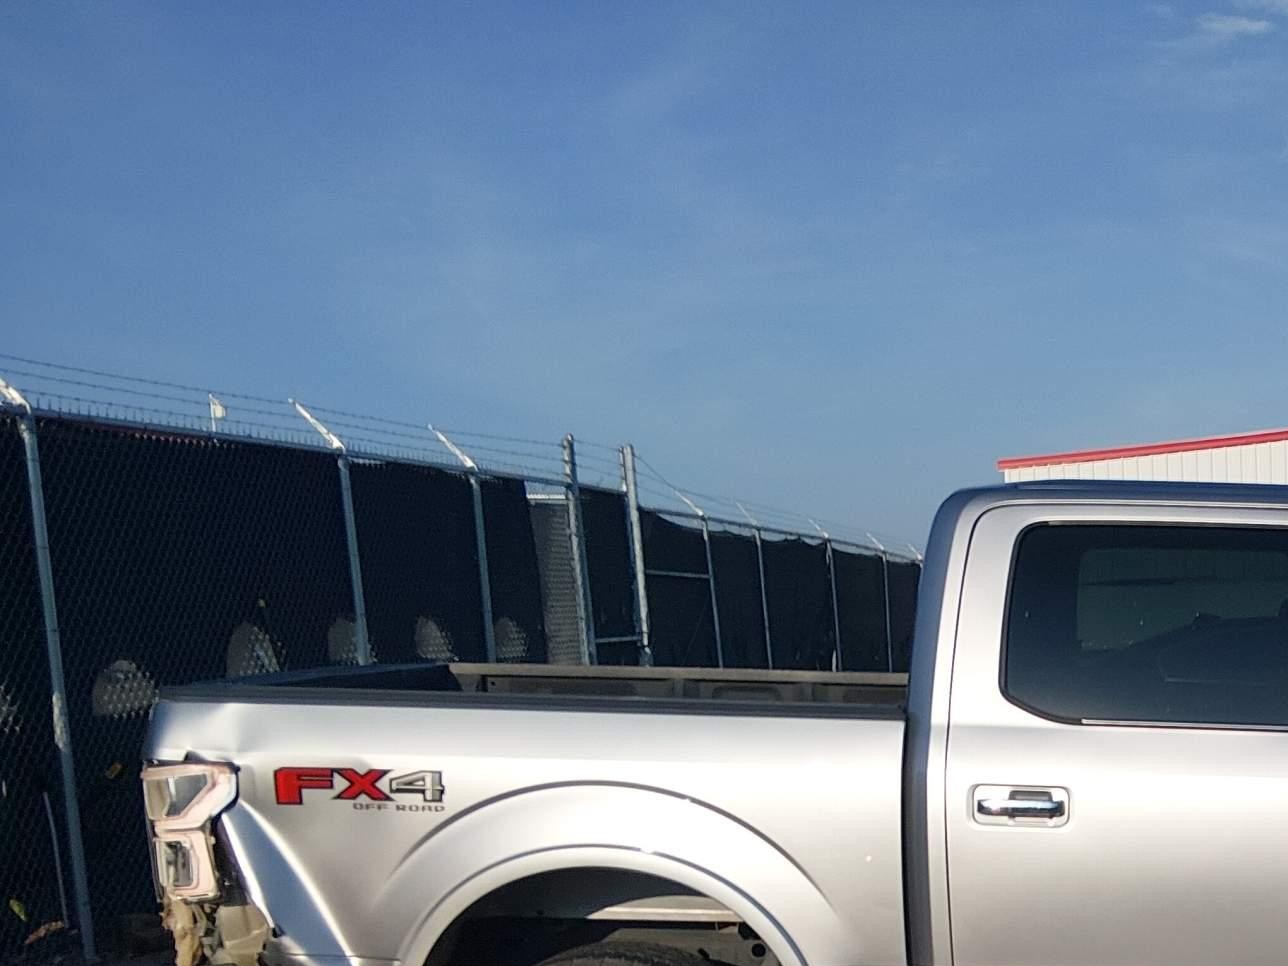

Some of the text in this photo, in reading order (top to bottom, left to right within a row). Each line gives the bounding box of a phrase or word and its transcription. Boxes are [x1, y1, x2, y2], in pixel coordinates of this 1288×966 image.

[274, 767, 445, 805] FX4
[352, 802, 446, 812] OFF ROAD
